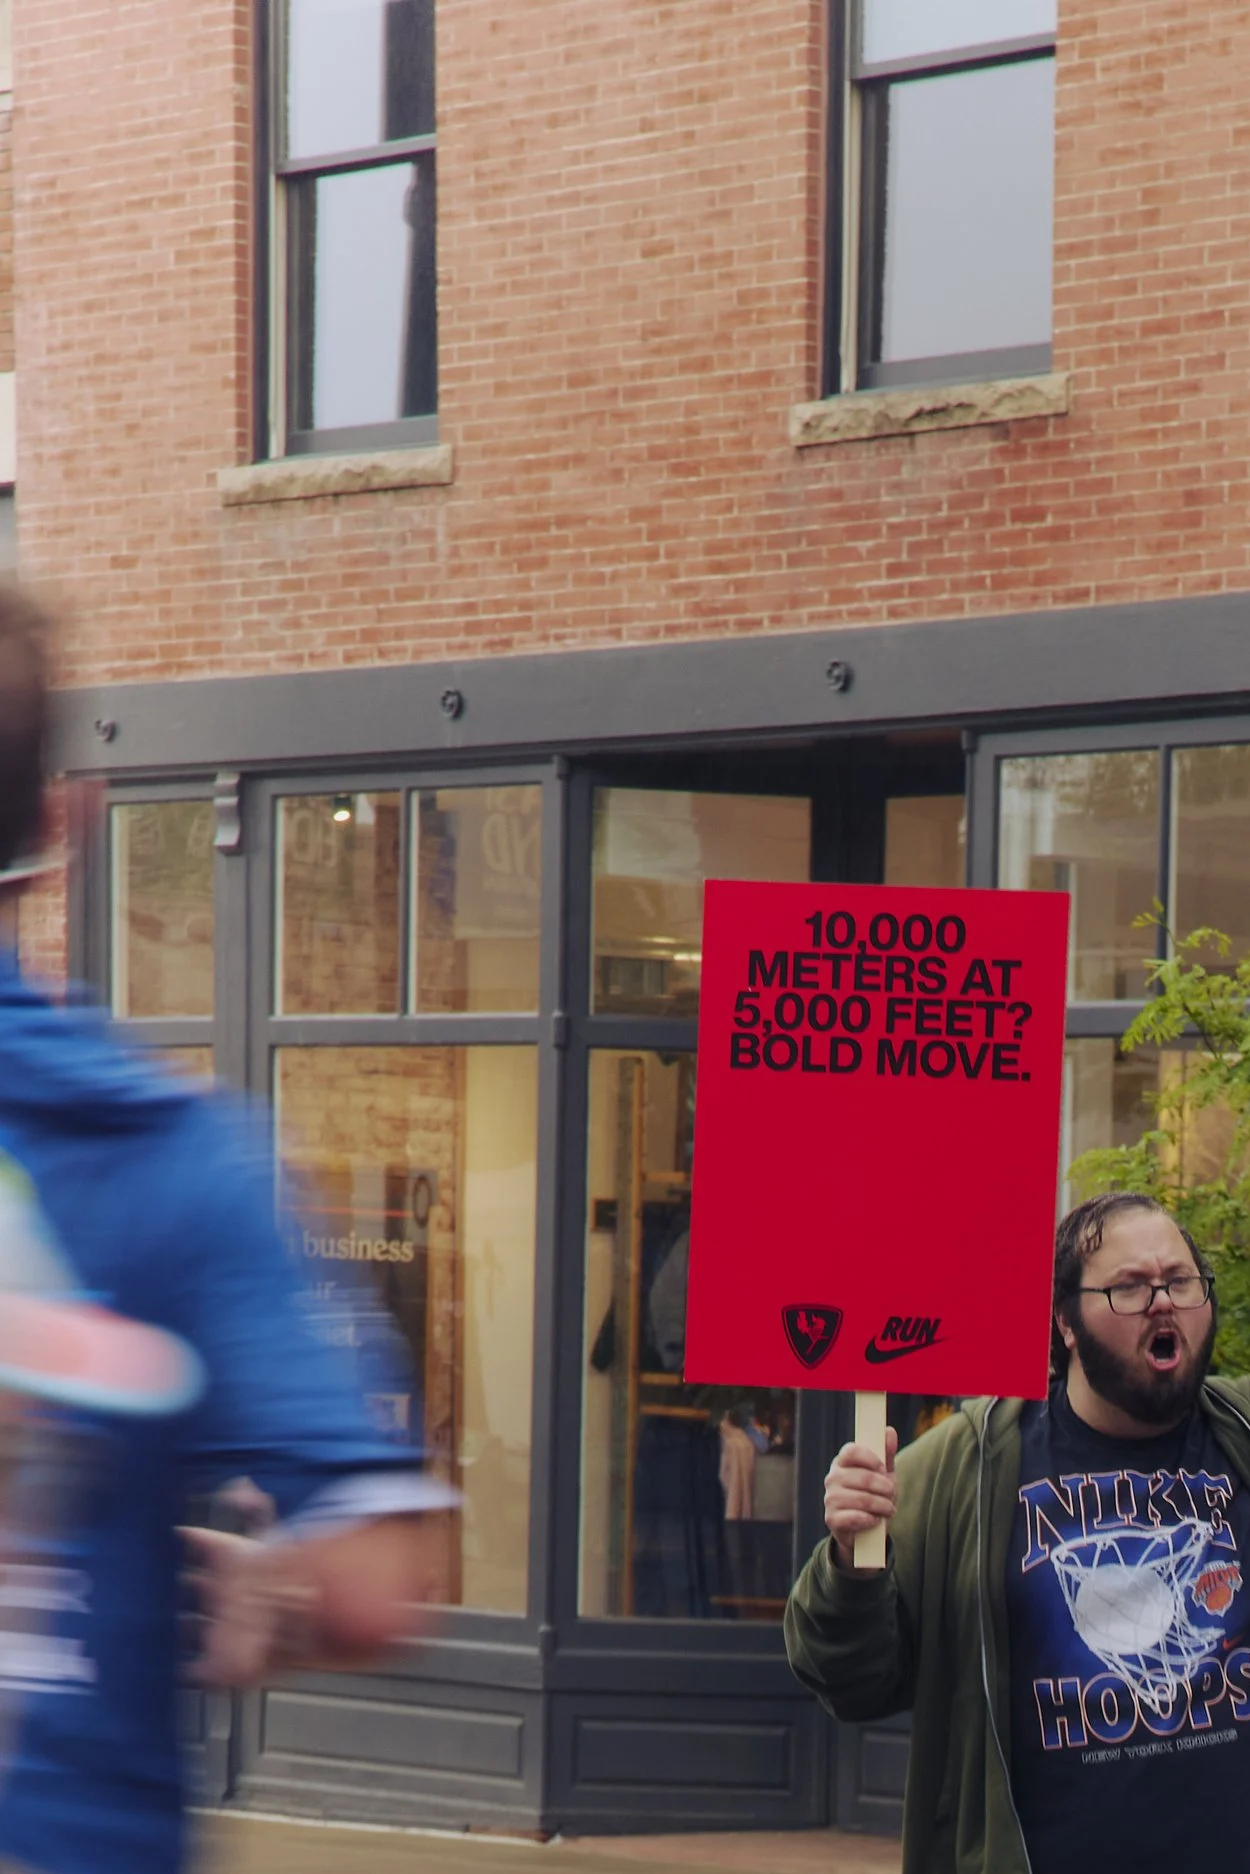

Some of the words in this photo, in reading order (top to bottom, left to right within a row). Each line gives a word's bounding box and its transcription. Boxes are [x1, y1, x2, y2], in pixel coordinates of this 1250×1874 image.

[805, 911, 967, 954] 10,000
[747, 950, 948, 995] METERS
[960, 959, 1022, 997] AT
[733, 991, 871, 1036] 5,000
[885, 998, 1033, 1039] FEET?
[730, 1032, 863, 1074] BOLD
[876, 1040, 1032, 1081] MOVE.
[302, 1231, 415, 1263] business
[881, 1316, 941, 1343] RUN
[1019, 1467, 1237, 1573] NIKE
[1081, 1748, 1121, 1764] NEW
